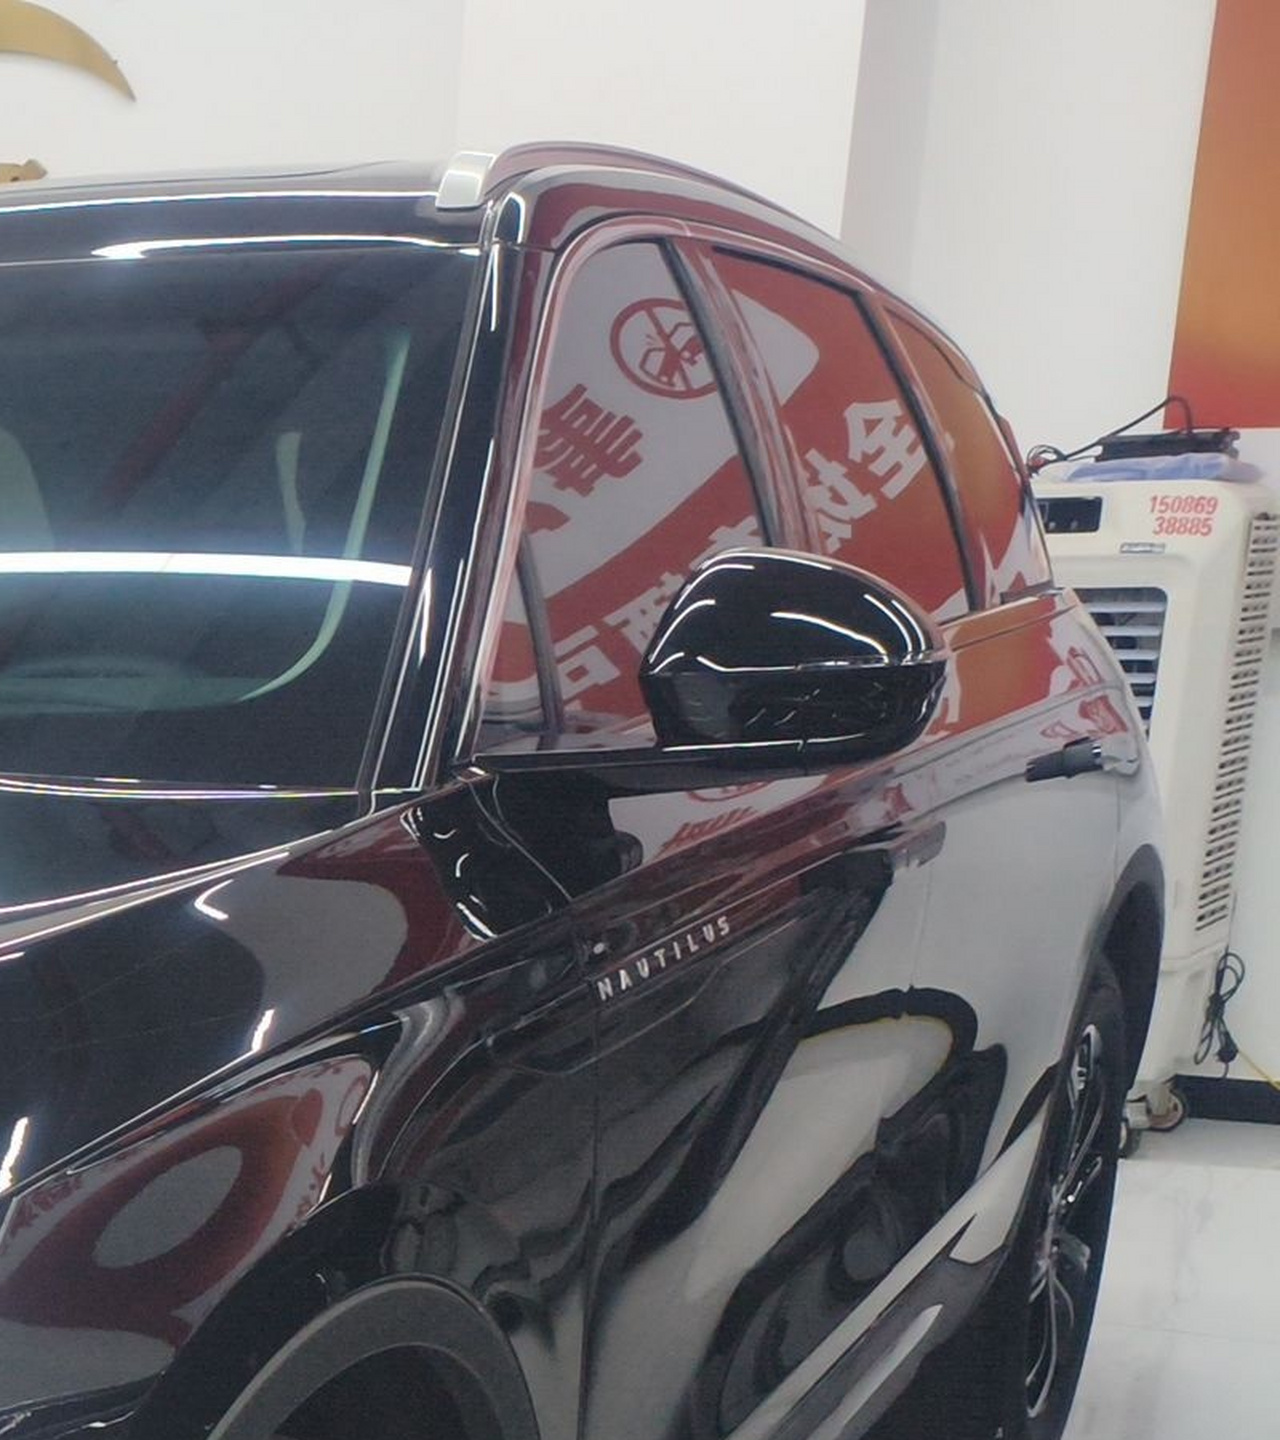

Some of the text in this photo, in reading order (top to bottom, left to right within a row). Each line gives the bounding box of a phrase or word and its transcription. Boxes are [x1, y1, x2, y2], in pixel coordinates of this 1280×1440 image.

[1149, 494, 1218, 515] 150869
[1151, 516, 1213, 537] 38885
[596, 915, 730, 1001] NAUTILUS
